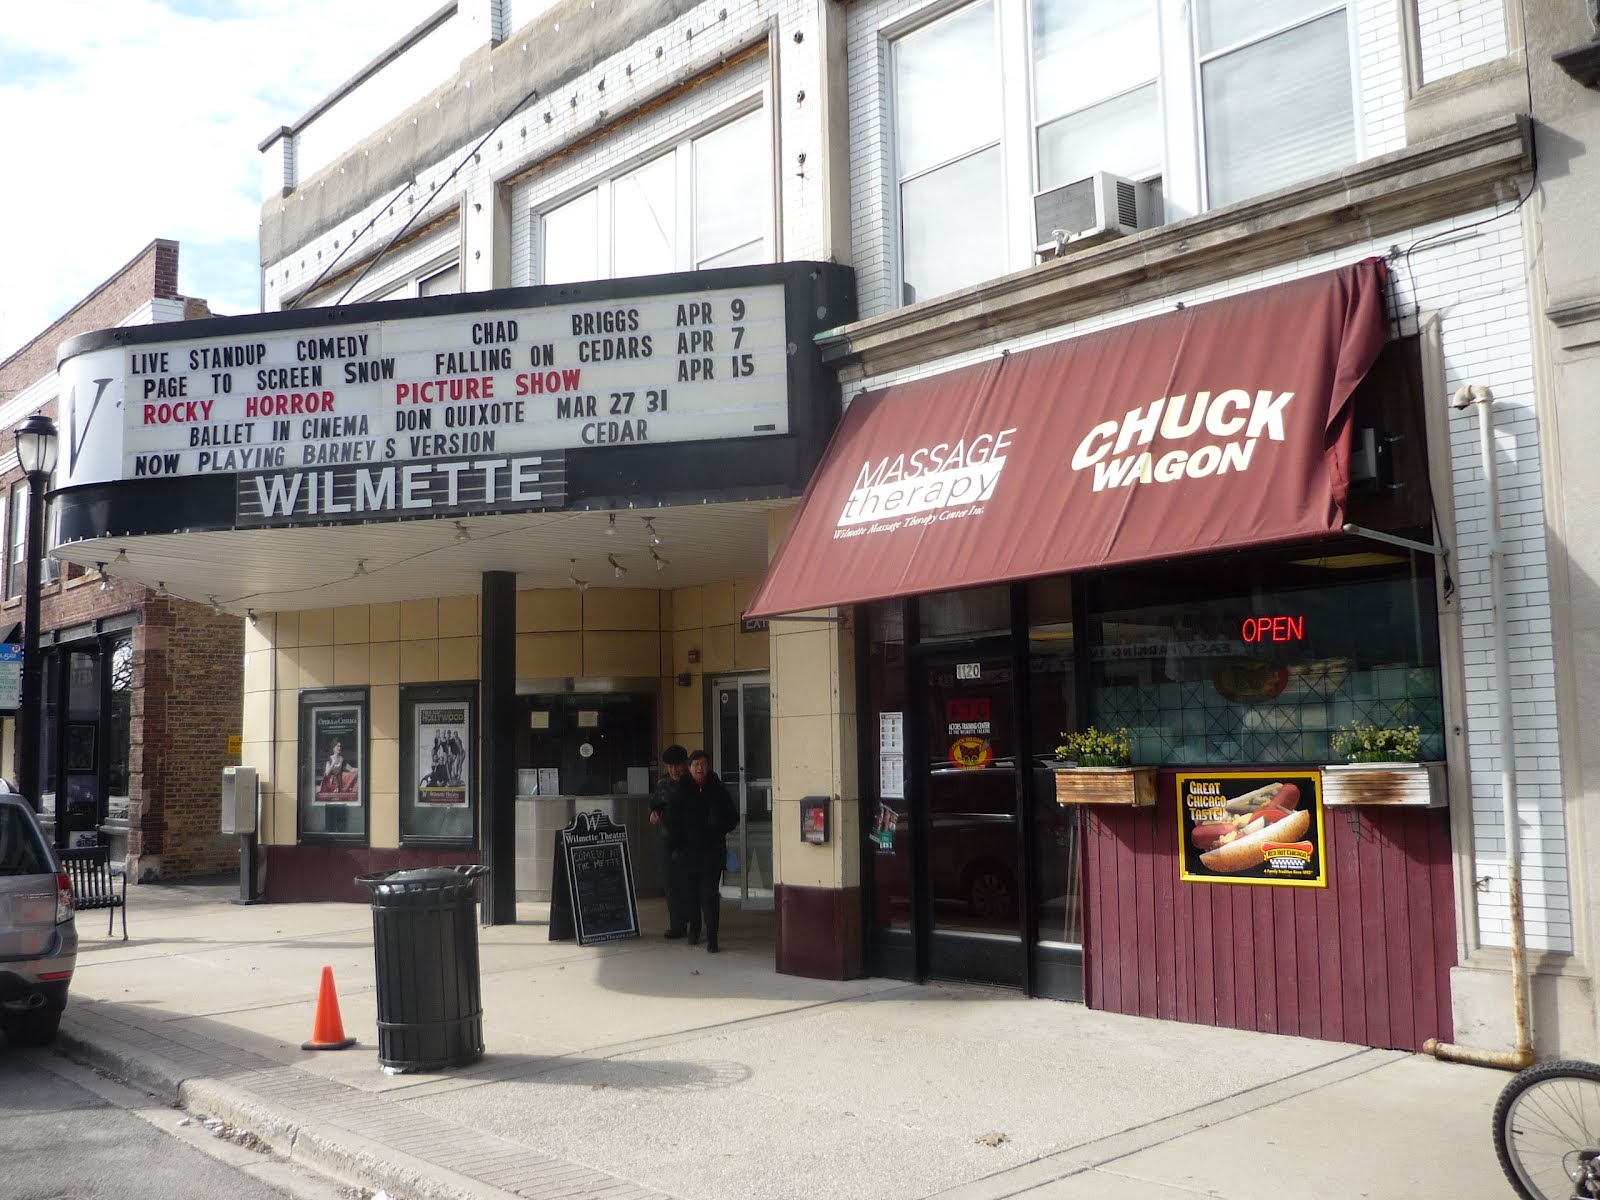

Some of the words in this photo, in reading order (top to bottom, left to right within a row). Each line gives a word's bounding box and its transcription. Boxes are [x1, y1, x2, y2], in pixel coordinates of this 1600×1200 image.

[132, 352, 169, 374] LIVE
[189, 343, 266, 371] STANDUP
[297, 334, 368, 361] COMEDY
[472, 320, 518, 345] CHAD
[572, 309, 639, 336] BRIGGS
[676, 302, 713, 327] APR
[730, 298, 745, 321] 9
[144, 376, 187, 399] PAGE
[212, 373, 232, 394] TO
[257, 366, 322, 391] SCREEN
[345, 358, 395, 384] SNOW
[436, 348, 512, 375] FALLING
[530, 344, 554, 367] ON
[579, 335, 652, 363] CEDARS
[677, 330, 714, 355] APR
[731, 327, 745, 349] 7
[143, 399, 214, 424] ROCKY
[246, 391, 334, 418] HORROR
[396, 376, 494, 405] PICTURE
[516, 368, 581, 396] SHOW
[677, 358, 714, 382] APR
[732, 354, 754, 378] 15
[189, 422, 255, 447] BALLET
[272, 420, 290, 441] IN
[302, 414, 368, 439] CINEMA
[396, 408, 432, 432] DON
[445, 401, 525, 428] QUIXOTE
[556, 395, 597, 419] MAR
[609, 392, 635, 415] 27
[646, 390, 667, 413] 31
[1071, 389, 1295, 471] CHUCK
[135, 453, 180, 476] NOW
[198, 446, 285, 472] PLAYING
[410, 430, 496, 457] VERSION
[581, 419, 648, 445] CEDAR
[857, 427, 1018, 490] MASSAGE
[1091, 437, 1257, 493] WAGON
[255, 456, 542, 517] WILMETTE
[845, 470, 1001, 518] therapy
[833, 528, 867, 540] Wilmette
[867, 520, 902, 534] Massage
[902, 514, 938, 528] Therapy
[938, 508, 967, 521] Center
[1242, 615, 1303, 643] OPEN
[957, 664, 979, 678] 1120
[1187, 795, 1227, 808] CHICAGO
[1189, 781, 1221, 794] GREAT
[1189, 807, 1225, 821] TASTE!
[565, 834, 599, 844] Wilmette
[599, 832, 626, 841] Theatre
